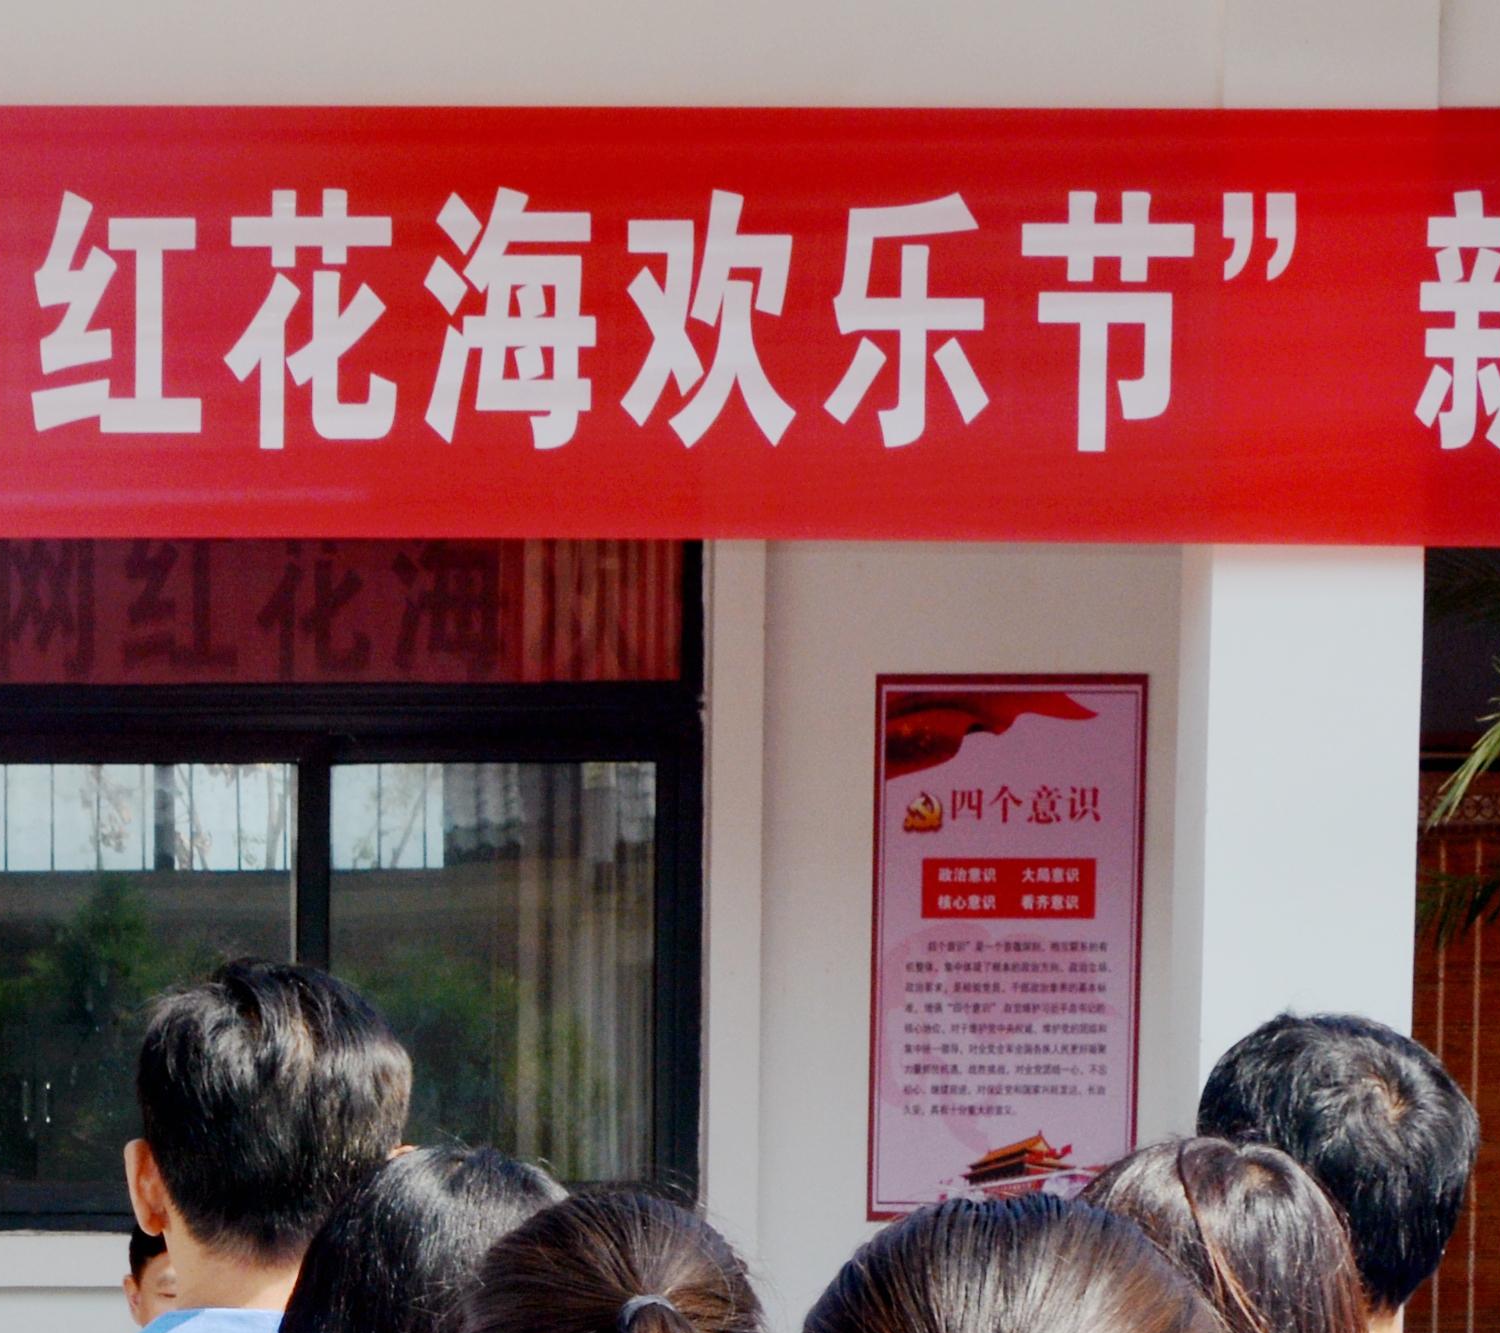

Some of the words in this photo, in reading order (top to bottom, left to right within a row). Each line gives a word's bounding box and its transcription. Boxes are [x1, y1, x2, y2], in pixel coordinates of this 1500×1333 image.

[951, 785, 1101, 824] 四个意识
[938, 867, 996, 882] 政治意识
[1022, 867, 1080, 882] 大局意识
[938, 895, 996, 910] 核心意识
